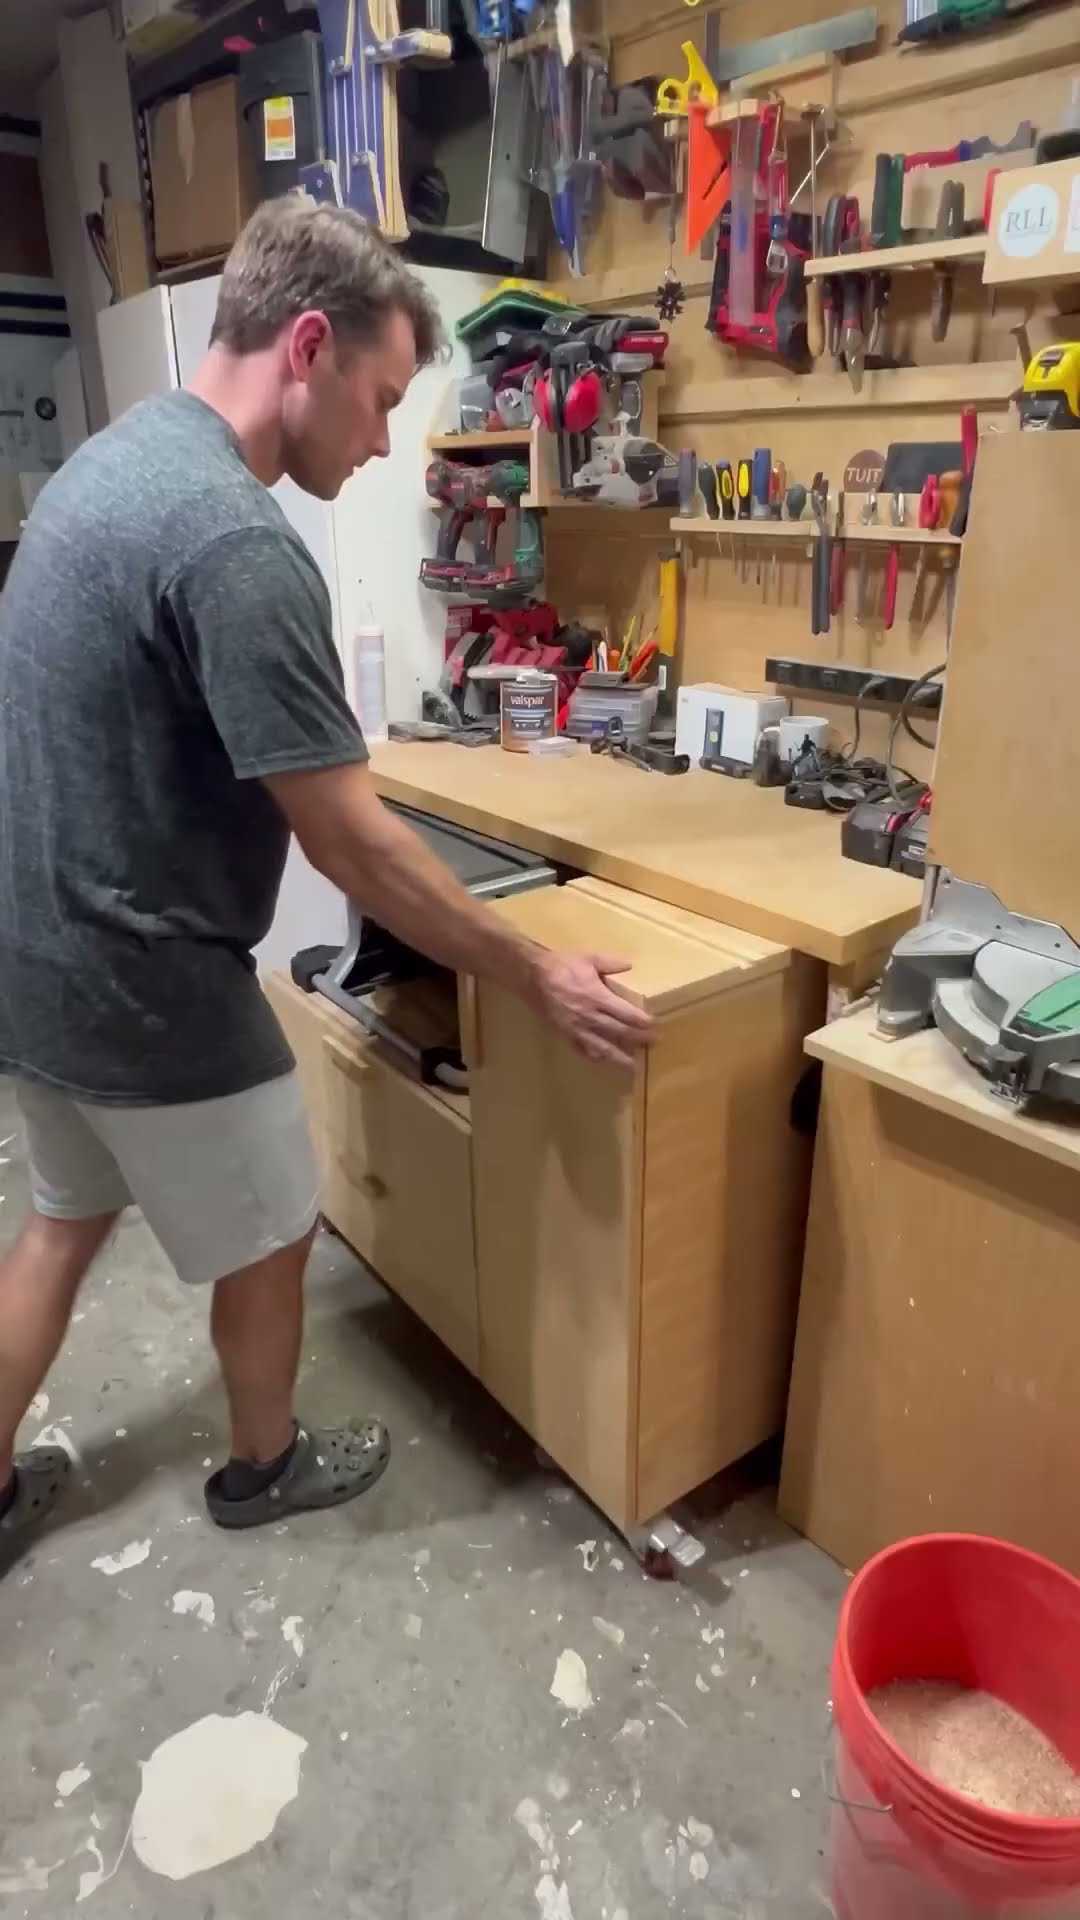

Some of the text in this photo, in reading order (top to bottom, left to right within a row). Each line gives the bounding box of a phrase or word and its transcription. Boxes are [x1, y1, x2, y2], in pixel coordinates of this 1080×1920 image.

[1005, 206, 1049, 232] RLL
[847, 467, 882, 483] TUIT
[510, 695, 545, 708] valspar
